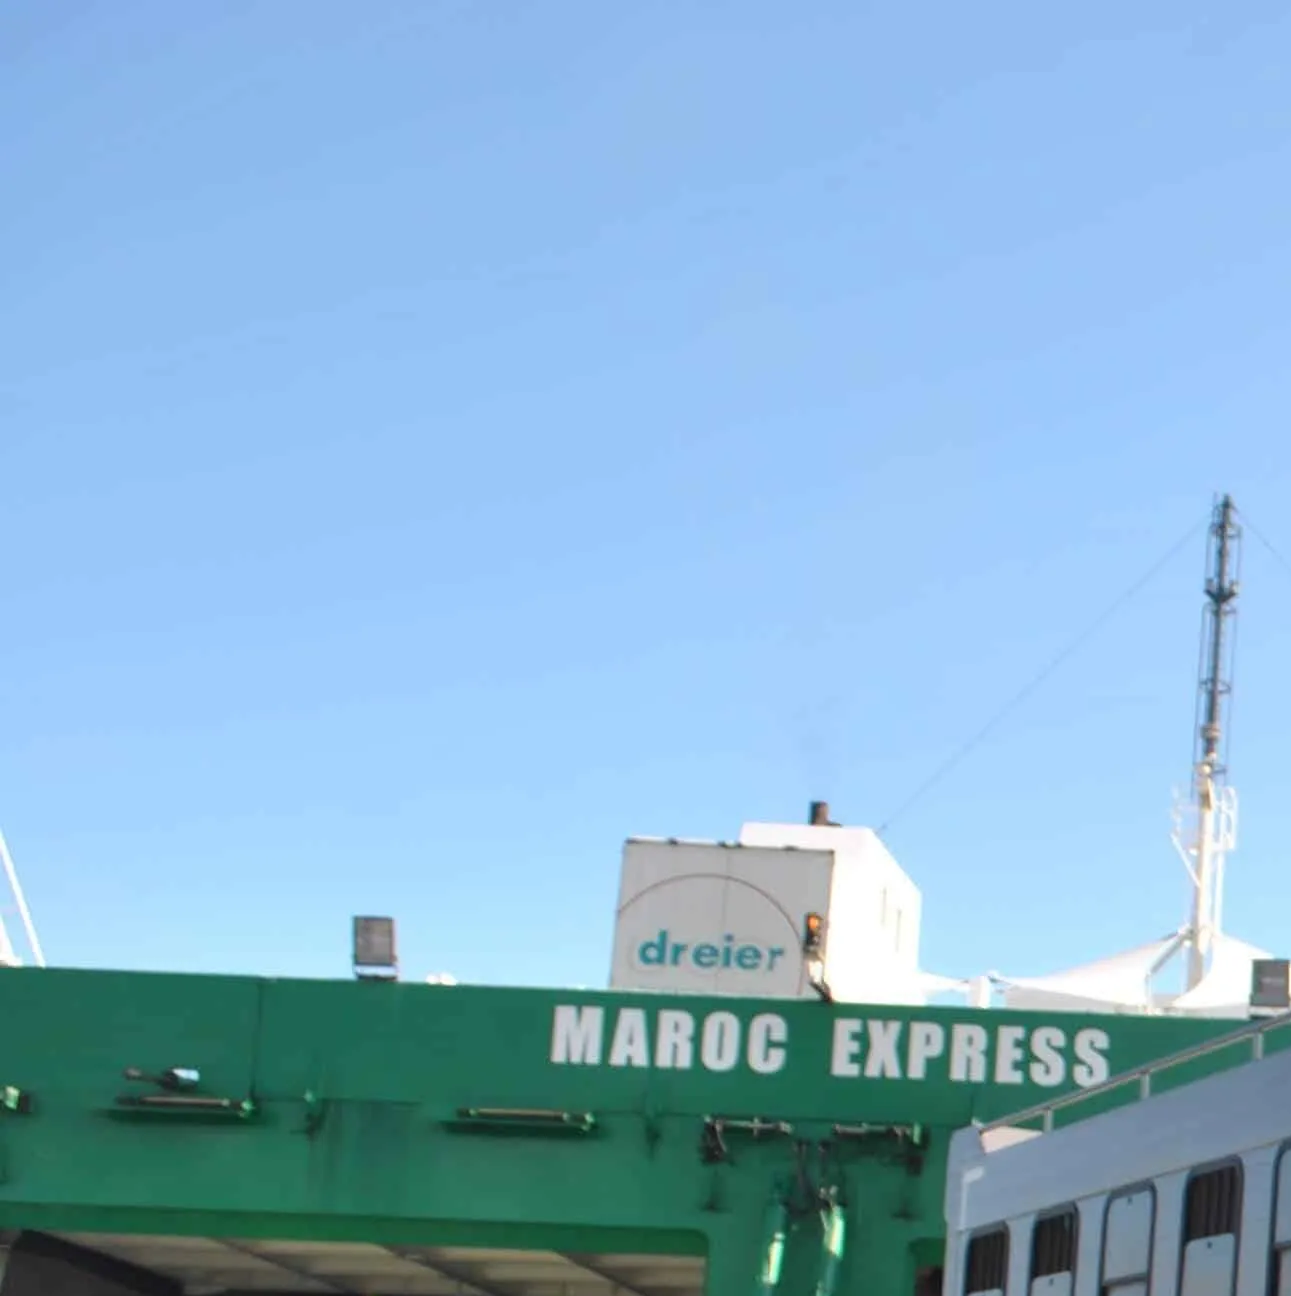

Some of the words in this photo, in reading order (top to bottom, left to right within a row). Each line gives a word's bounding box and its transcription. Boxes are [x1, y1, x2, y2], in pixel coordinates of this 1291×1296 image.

[637, 928, 786, 972] dreier
[551, 1004, 789, 1074] MAROC
[830, 1017, 1111, 1088] EXPRESS
